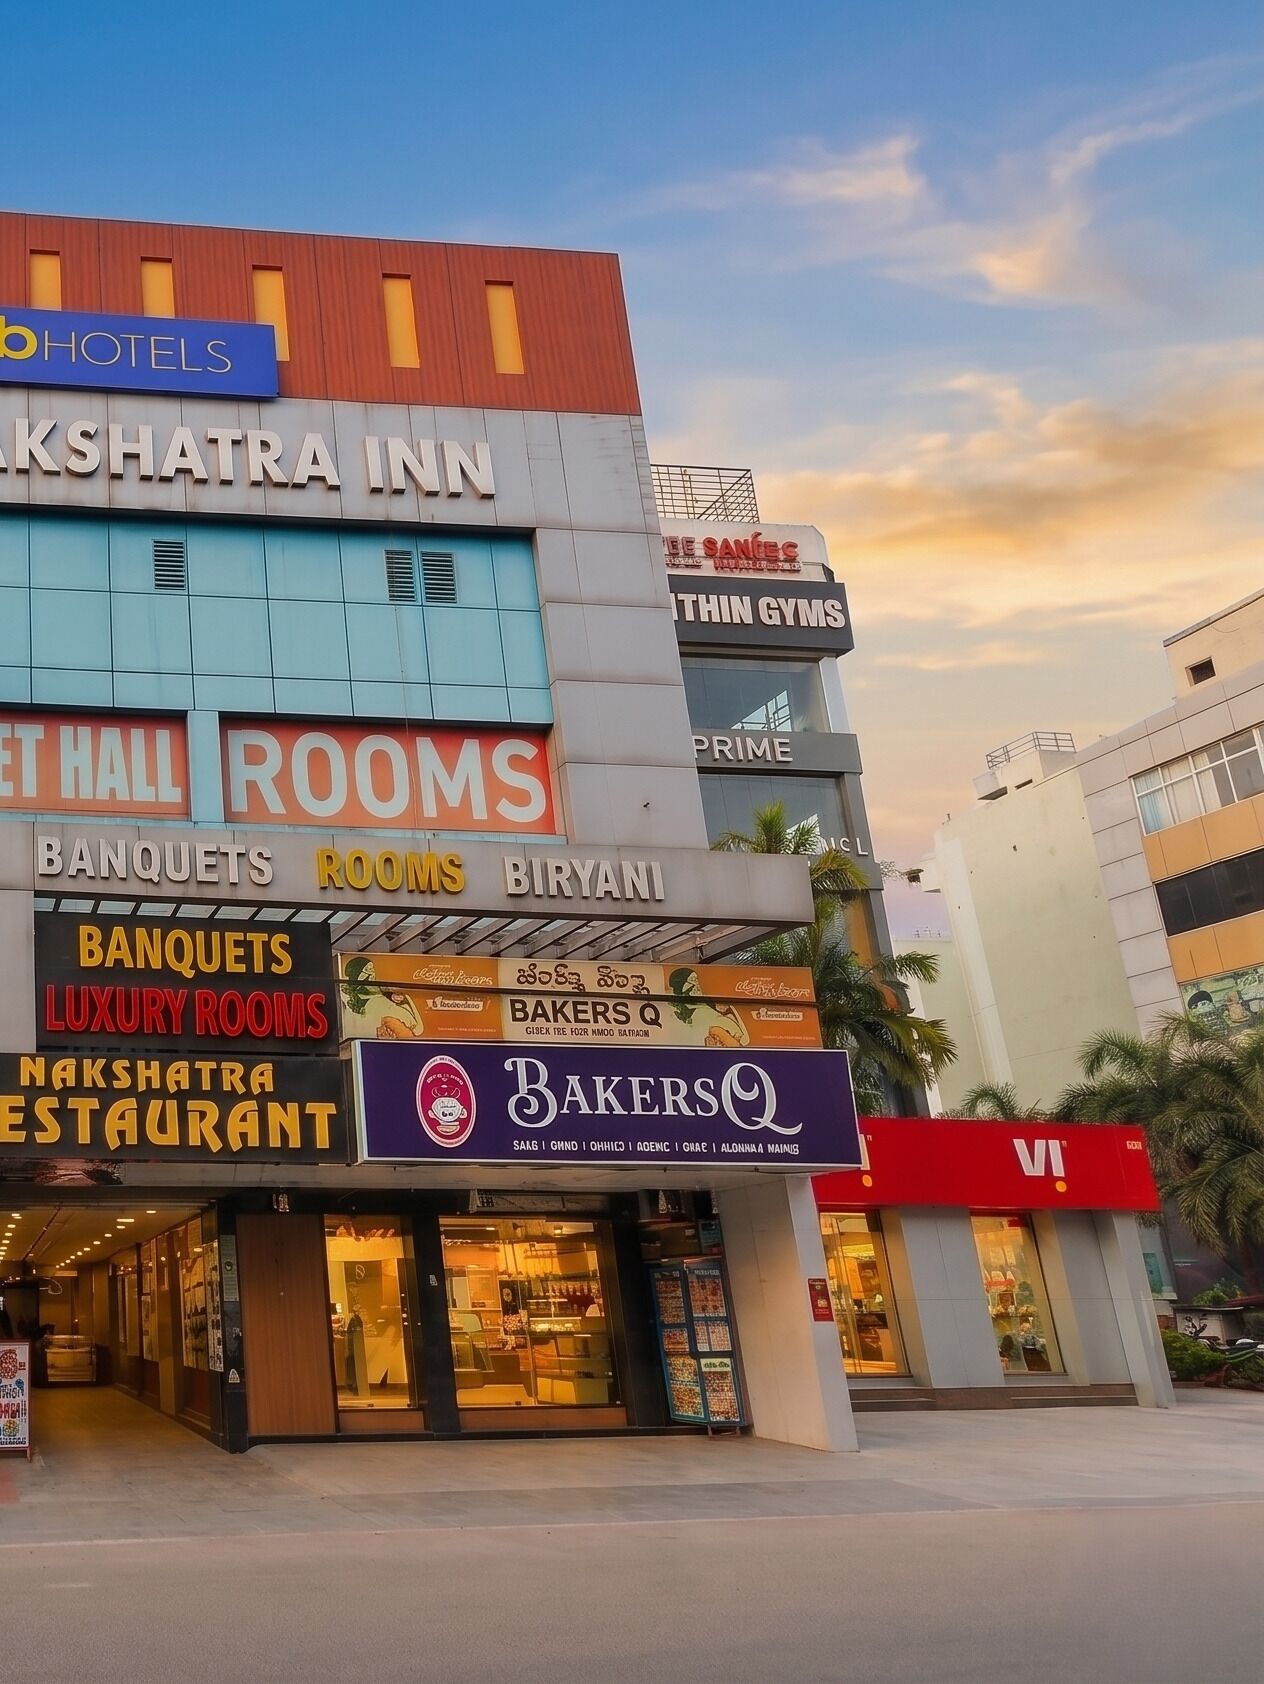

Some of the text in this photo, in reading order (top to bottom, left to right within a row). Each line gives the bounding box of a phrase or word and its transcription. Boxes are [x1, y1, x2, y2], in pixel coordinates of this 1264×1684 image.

[363, 435, 496, 498] INN
[758, 597, 846, 629] GYMS
[59, 725, 183, 803] HALL
[692, 735, 793, 762] PRIME
[228, 729, 547, 823] ROOMS
[37, 834, 273, 886] BANQUETS
[316, 848, 466, 893] ROOMS
[504, 855, 665, 901] BIRYANI
[79, 925, 293, 978] BANQUETS
[46, 984, 329, 1039] LUXURY ROOMS
[509, 999, 631, 1025] BAKERS
[639, 1002, 663, 1029] Q
[19, 1056, 275, 1095] NAKSHATRA
